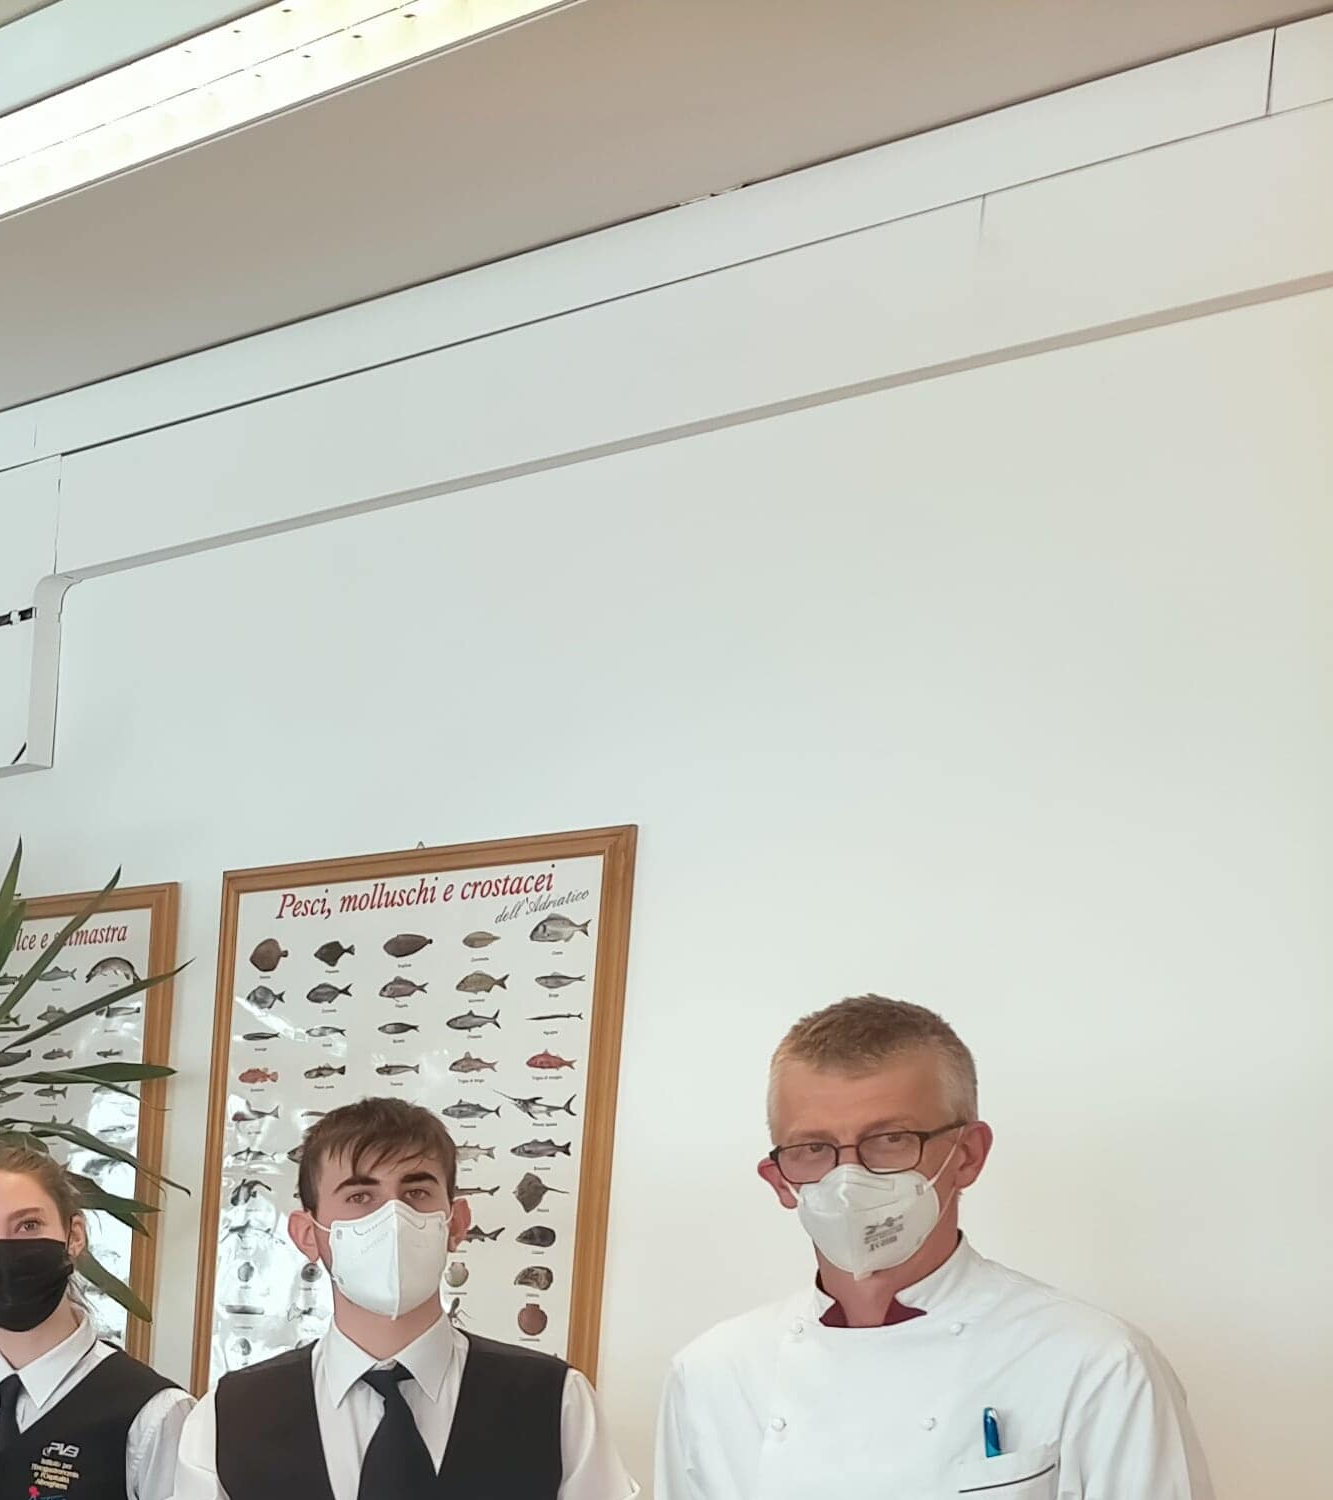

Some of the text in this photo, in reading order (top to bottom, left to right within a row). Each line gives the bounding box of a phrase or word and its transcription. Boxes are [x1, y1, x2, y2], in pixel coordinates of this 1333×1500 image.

[276, 864, 556, 920] Pesci, molluschi e crostacei
[40, 936, 49, 950] e
